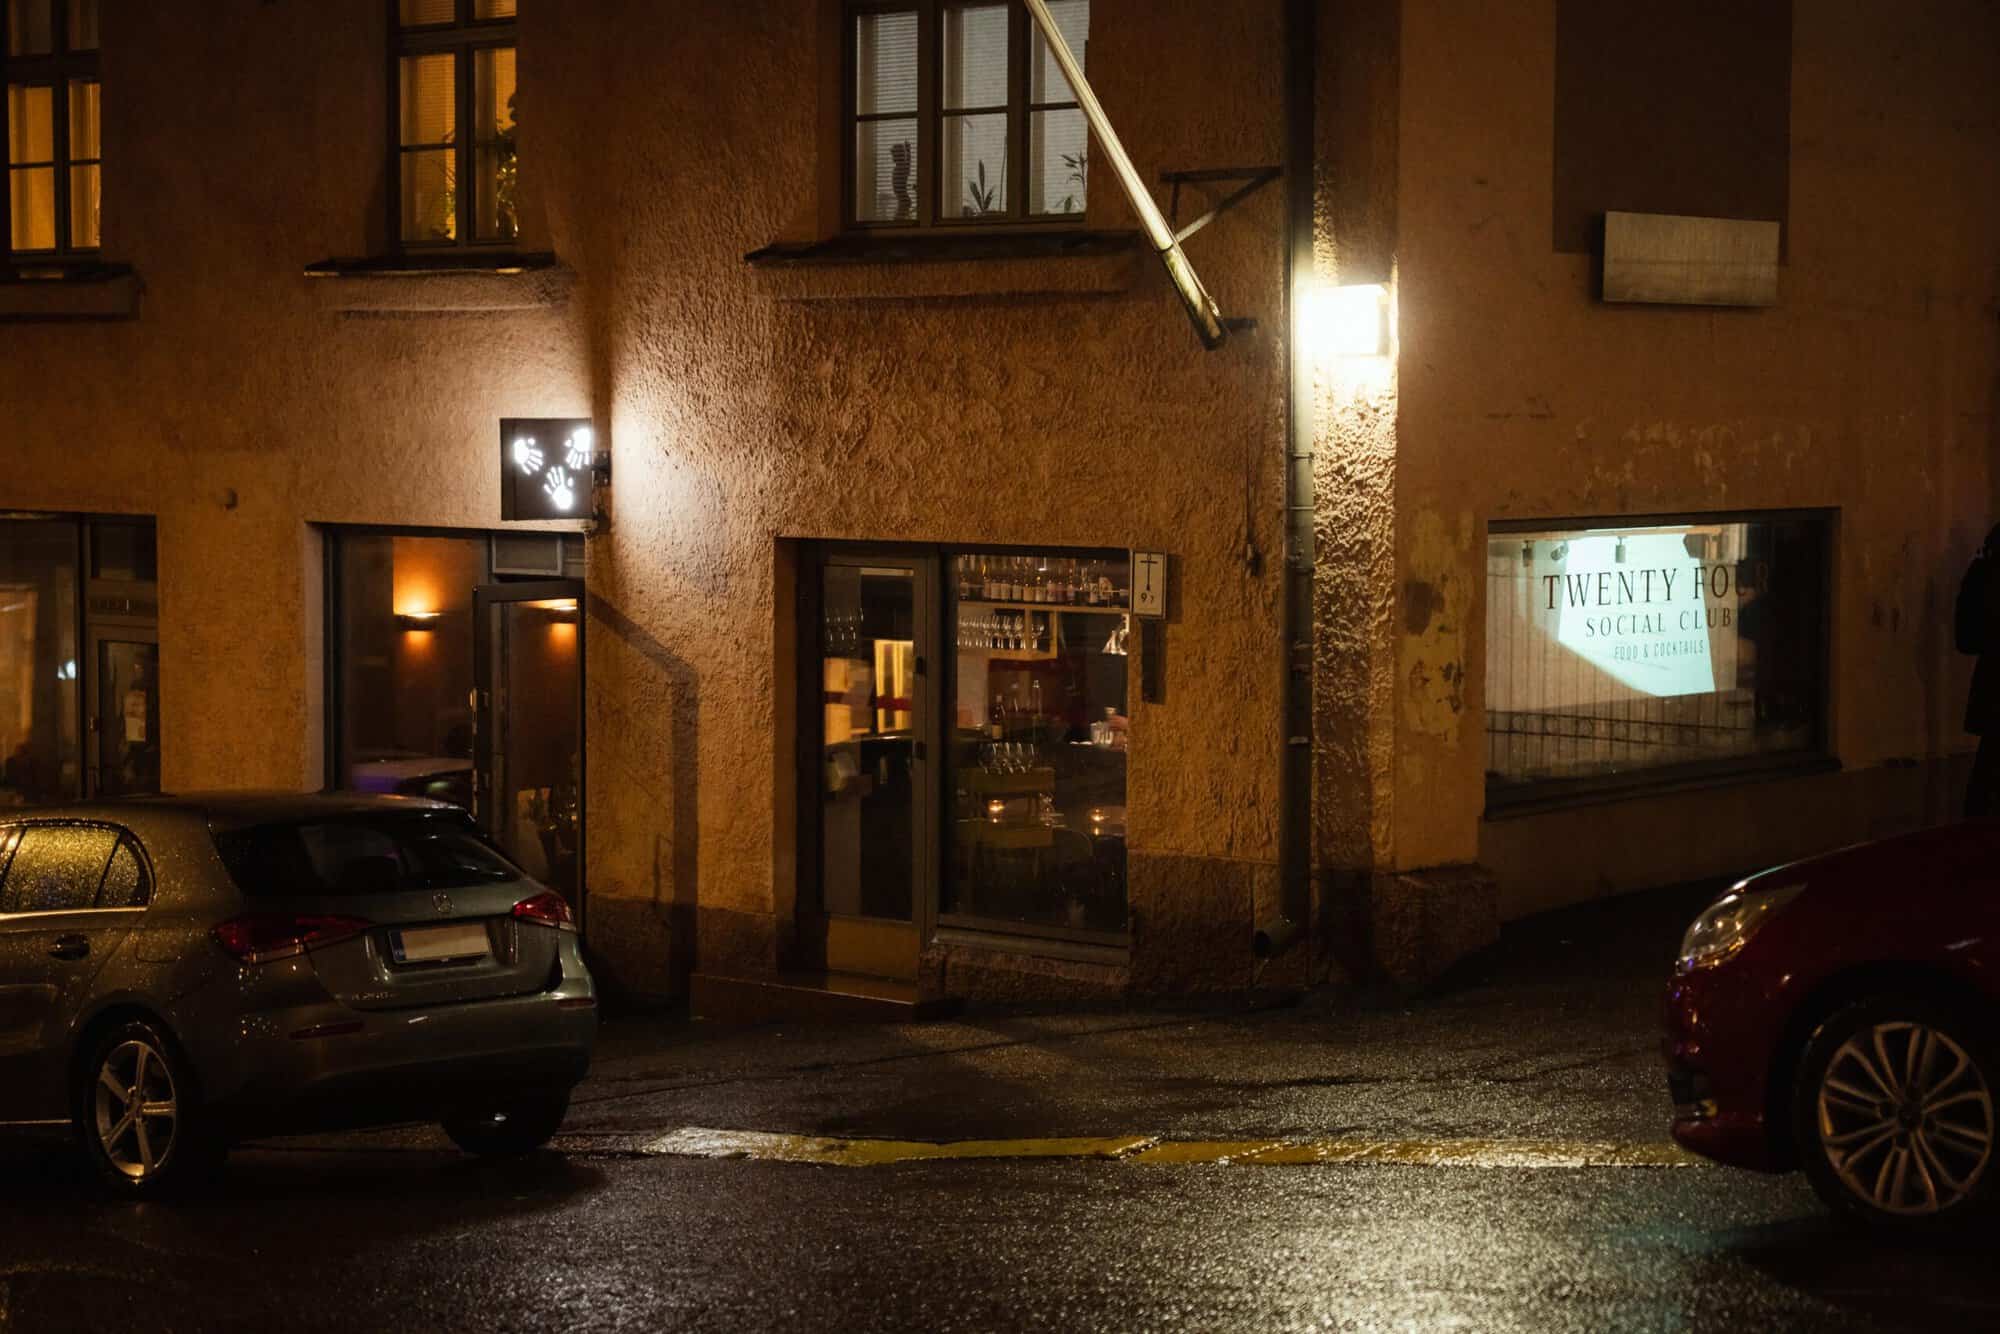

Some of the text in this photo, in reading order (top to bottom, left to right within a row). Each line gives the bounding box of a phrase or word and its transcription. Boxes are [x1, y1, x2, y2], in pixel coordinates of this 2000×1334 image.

[1543, 567, 1678, 610] TWENTY
[1586, 608, 1732, 638] SOCIAL CLUB
[1614, 645, 1639, 660] FOOD
[1654, 639, 1704, 657] COCKTAILS
